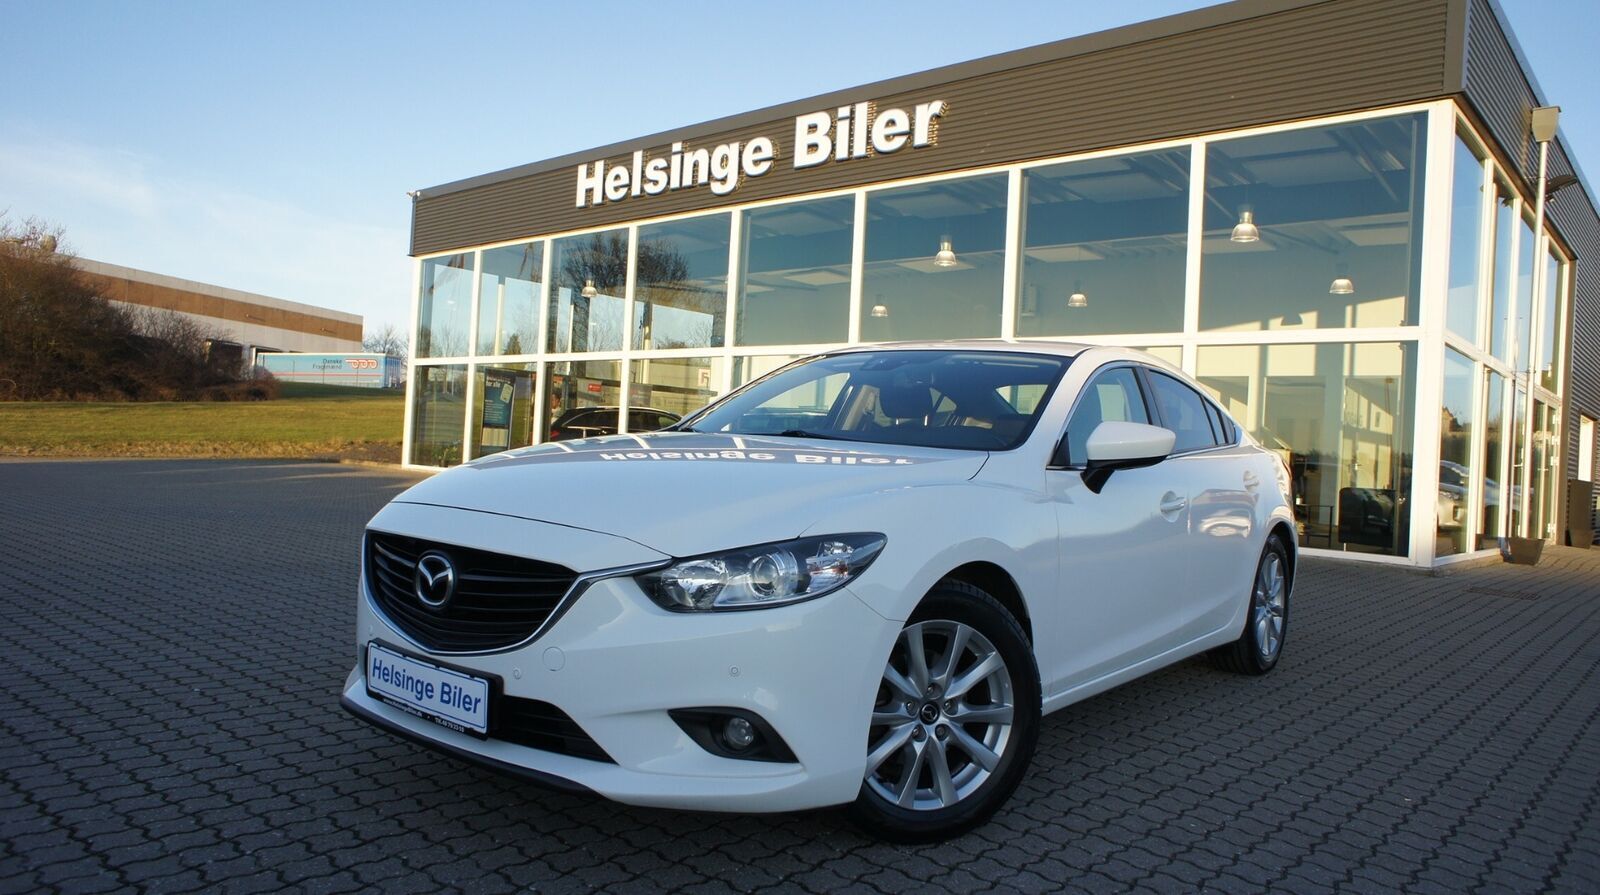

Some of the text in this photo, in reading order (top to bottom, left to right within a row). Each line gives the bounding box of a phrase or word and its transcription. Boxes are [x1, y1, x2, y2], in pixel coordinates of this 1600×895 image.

[575, 100, 947, 208] Helsinge Biler
[372, 658, 434, 701] Helsinge
[440, 682, 481, 714] Biler
